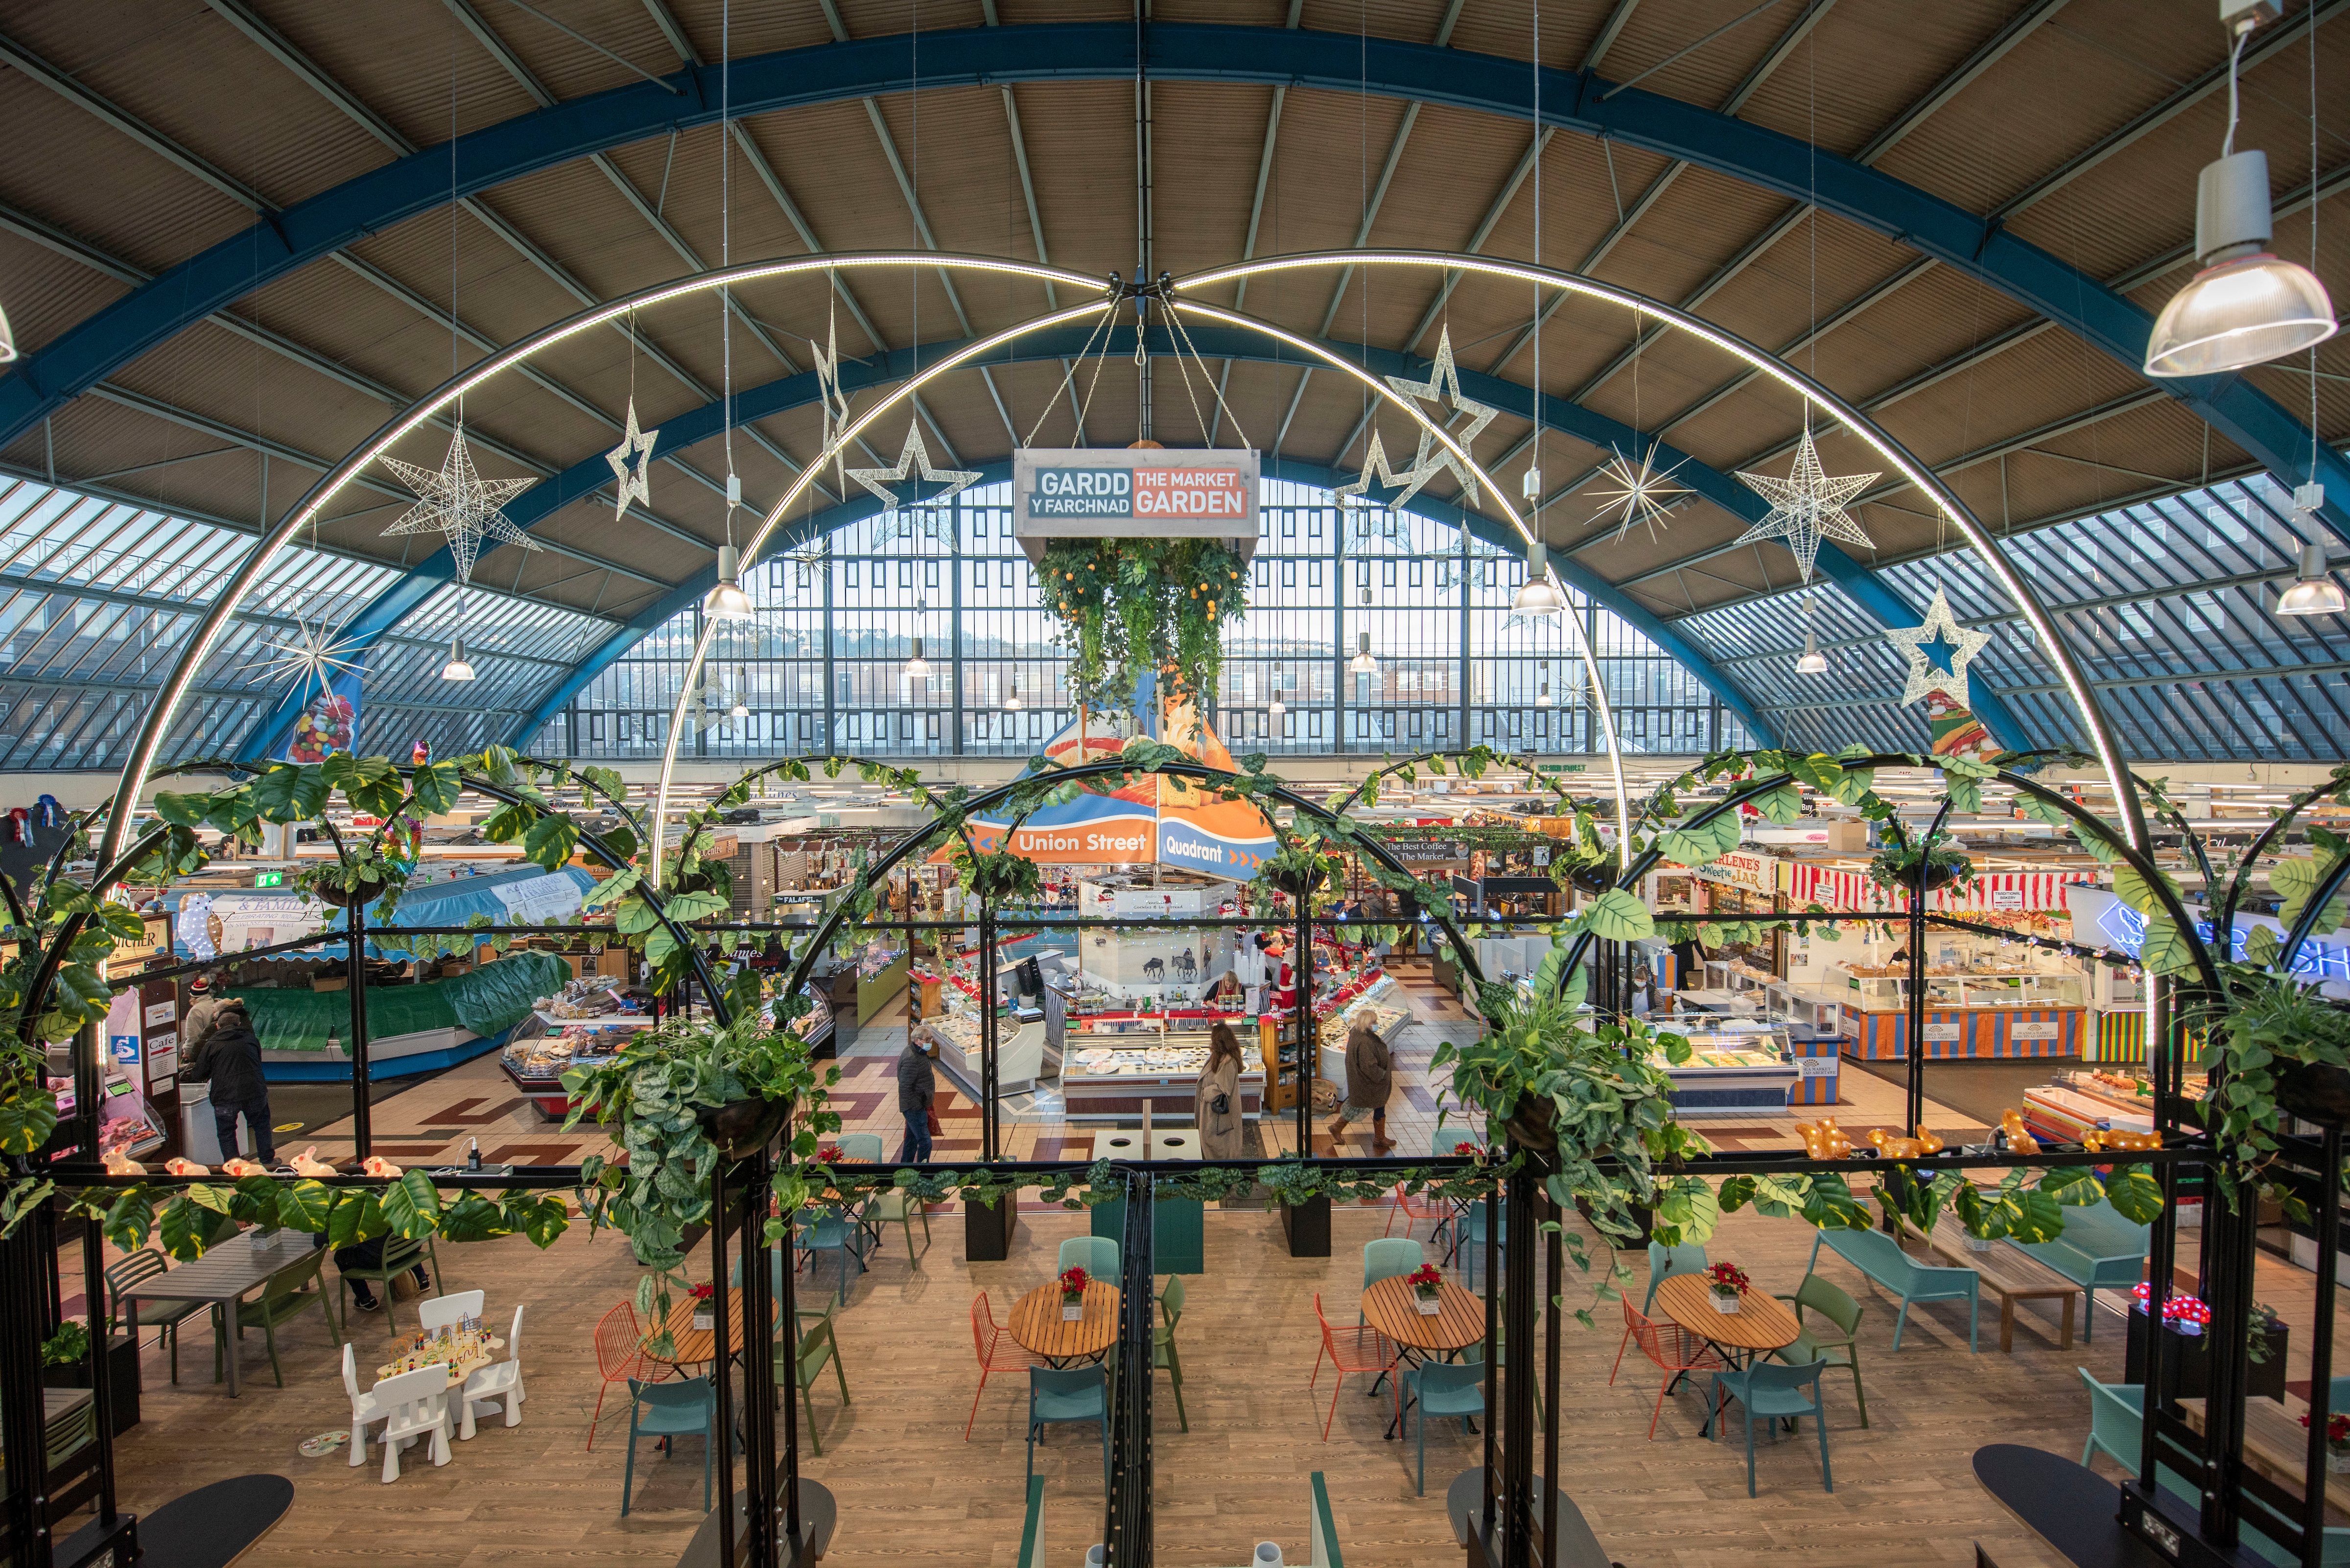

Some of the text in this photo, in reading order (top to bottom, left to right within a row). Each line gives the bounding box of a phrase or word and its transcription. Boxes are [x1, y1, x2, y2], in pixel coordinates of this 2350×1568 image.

[1041, 472, 1129, 495] GARDD
[1136, 473, 1236, 486] THE MARKET
[1032, 499, 1129, 513] Y FARCHNAD
[1136, 491, 1242, 513] GARDEN
[1802, 804, 1813, 812] Buy
[663, 838, 682, 846] WATCH
[1019, 834, 1147, 851] Union Street
[703, 846, 723, 857] Centre
[1166, 836, 1222, 863] Quadrant
[1699, 865, 1763, 890] Sweetie JAR
[239, 901, 307, 911] & FAMILY
[2196, 922, 2350, 982] FRSH
[149, 1035, 175, 1049] Cafe
